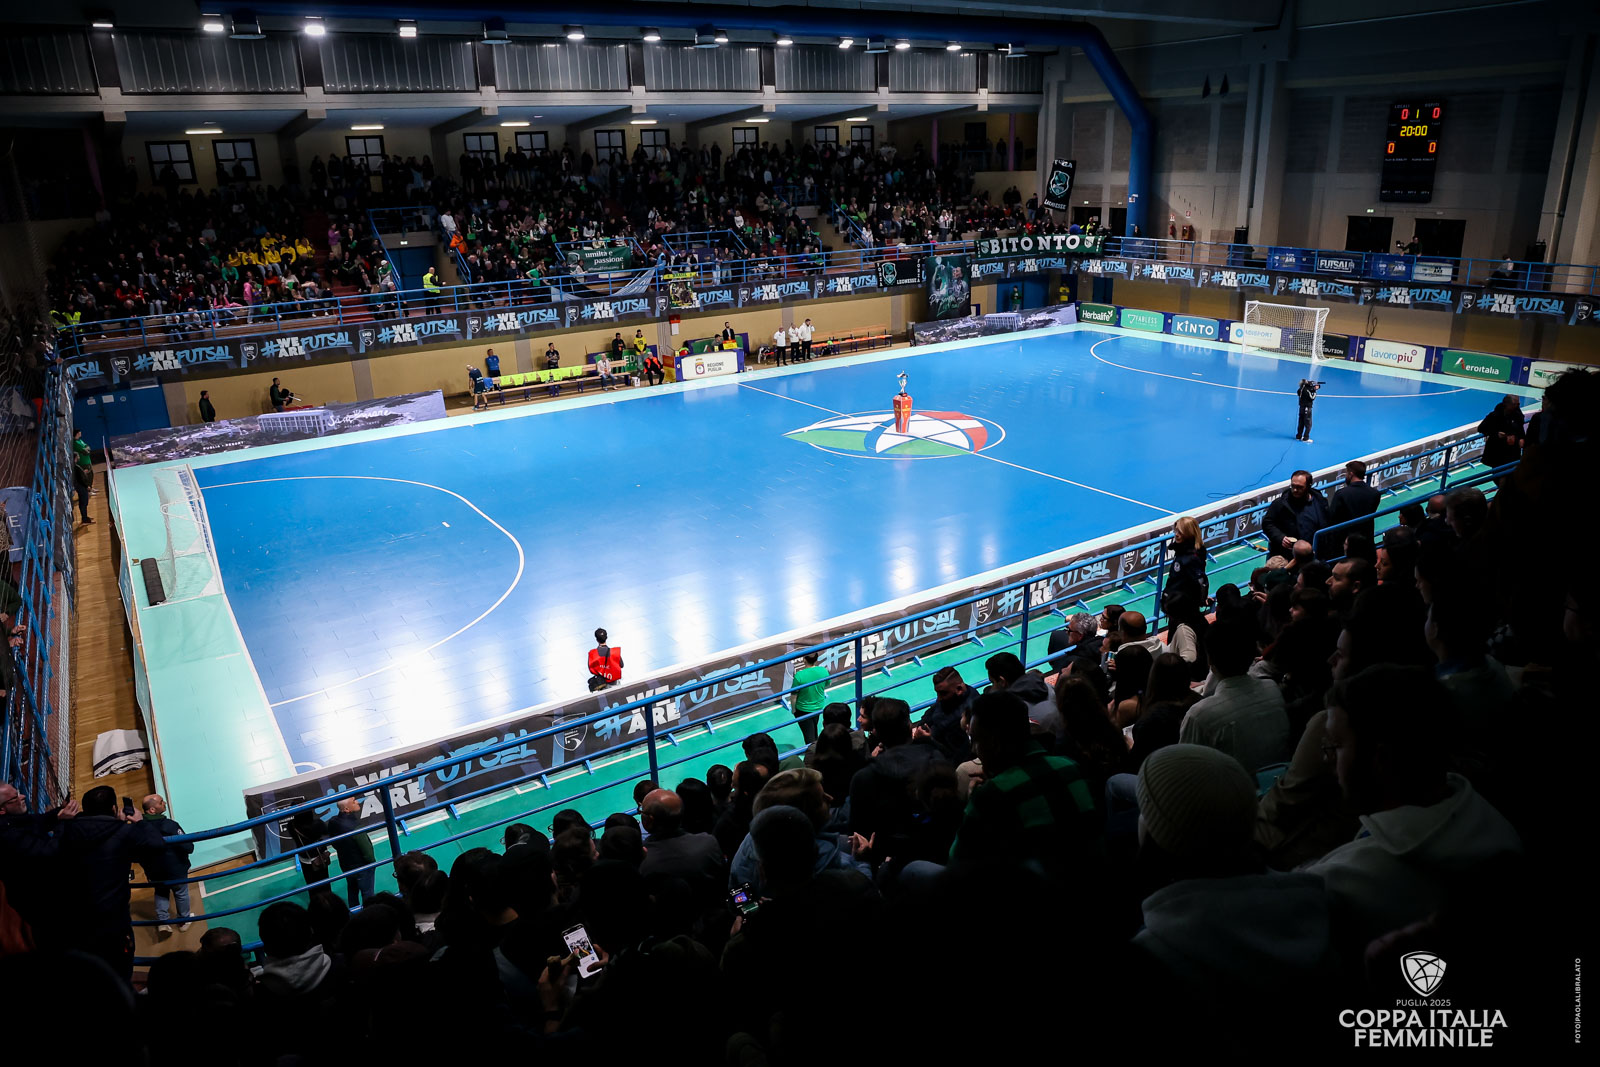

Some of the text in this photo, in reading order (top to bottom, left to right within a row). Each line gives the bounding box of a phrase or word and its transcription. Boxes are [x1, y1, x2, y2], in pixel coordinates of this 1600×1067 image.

[1400, 108, 1409, 120] 0
[1416, 108, 1420, 120] 1
[1432, 107, 1440, 120] 0
[1400, 125, 1428, 136] 20:00
[1387, 142, 1396, 154] 0
[1428, 141, 1436, 153] 0
[594, 256, 624, 266] passione
[778, 280, 810, 295] FUTSAL
[850, 274, 878, 288] FUTSA
[1317, 282, 1356, 296] FUTSAL
[1409, 288, 1452, 304] FUTSAL
[611, 298, 651, 312] FUTSAL
[1515, 297, 1566, 315] FUTSAL
[518, 308, 560, 324] FUTSAL
[412, 320, 460, 335] FUTSAL
[300, 332, 353, 350] FUTSAL
[176, 345, 234, 363] FUTSAL
[1454, 357, 1500, 374] Aeroitalia
[416, 729, 536, 792] FUTSAL
